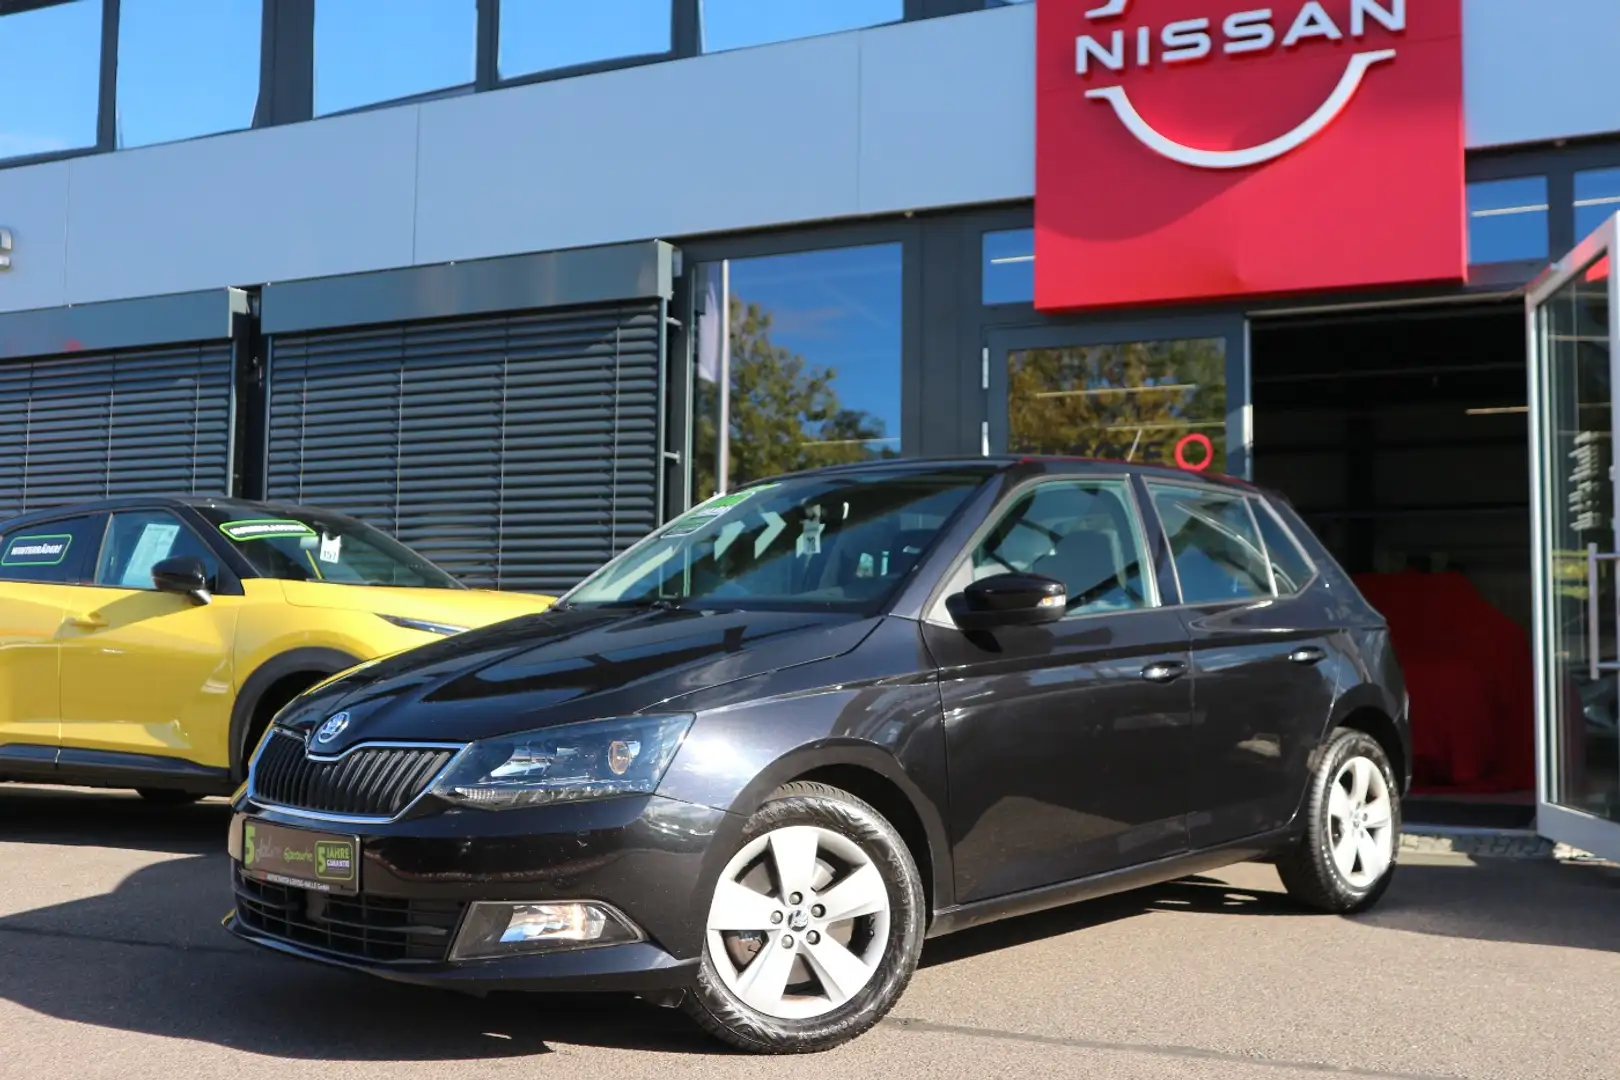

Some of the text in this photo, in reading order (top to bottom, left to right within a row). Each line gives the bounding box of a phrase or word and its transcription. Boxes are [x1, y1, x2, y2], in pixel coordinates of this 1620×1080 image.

[1075, 0, 1406, 74] NISSAN
[317, 846, 326, 873] 5
[326, 846, 350, 859] JAHRE
